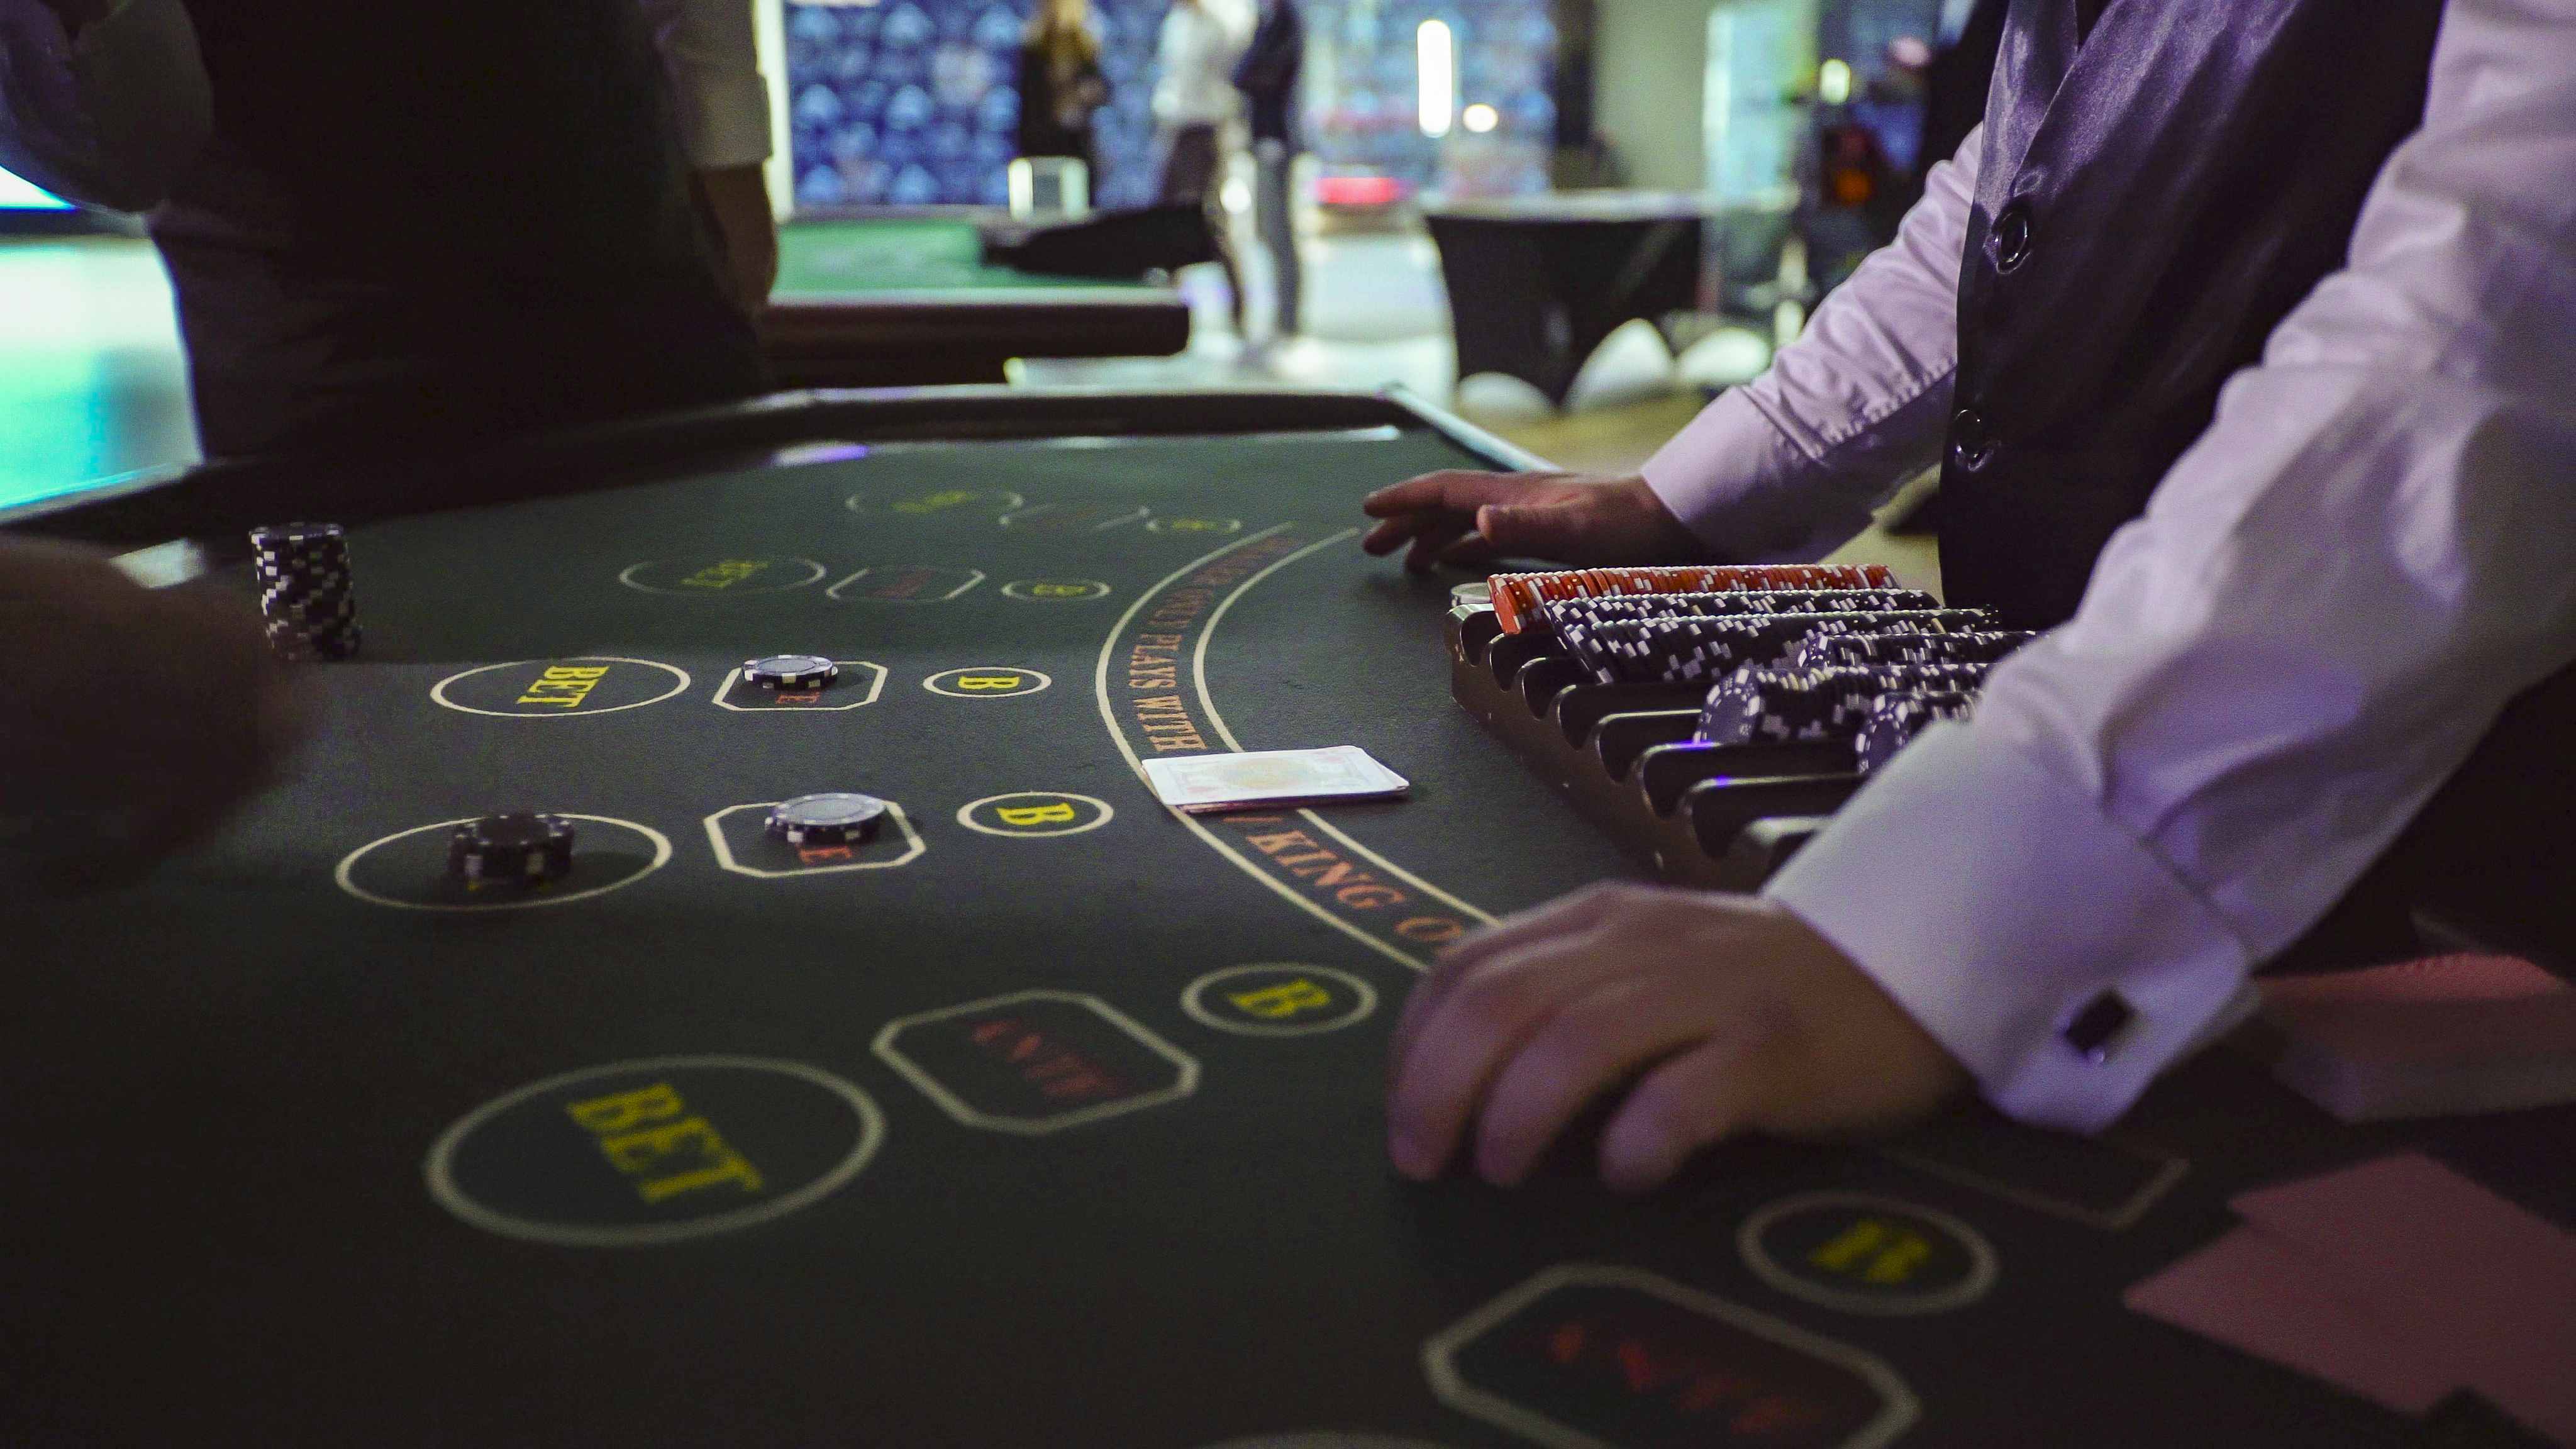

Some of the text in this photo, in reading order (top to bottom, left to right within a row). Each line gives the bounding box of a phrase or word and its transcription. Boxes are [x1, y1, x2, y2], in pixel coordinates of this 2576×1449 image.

[958, 676, 1020, 689] B
[1129, 633, 1182, 689] PLAYS
[516, 665, 610, 708] BET
[1133, 695, 1208, 752] WITH
[996, 802, 1074, 826] B
[1228, 978, 1331, 1018] B
[565, 1080, 763, 1206] BET
